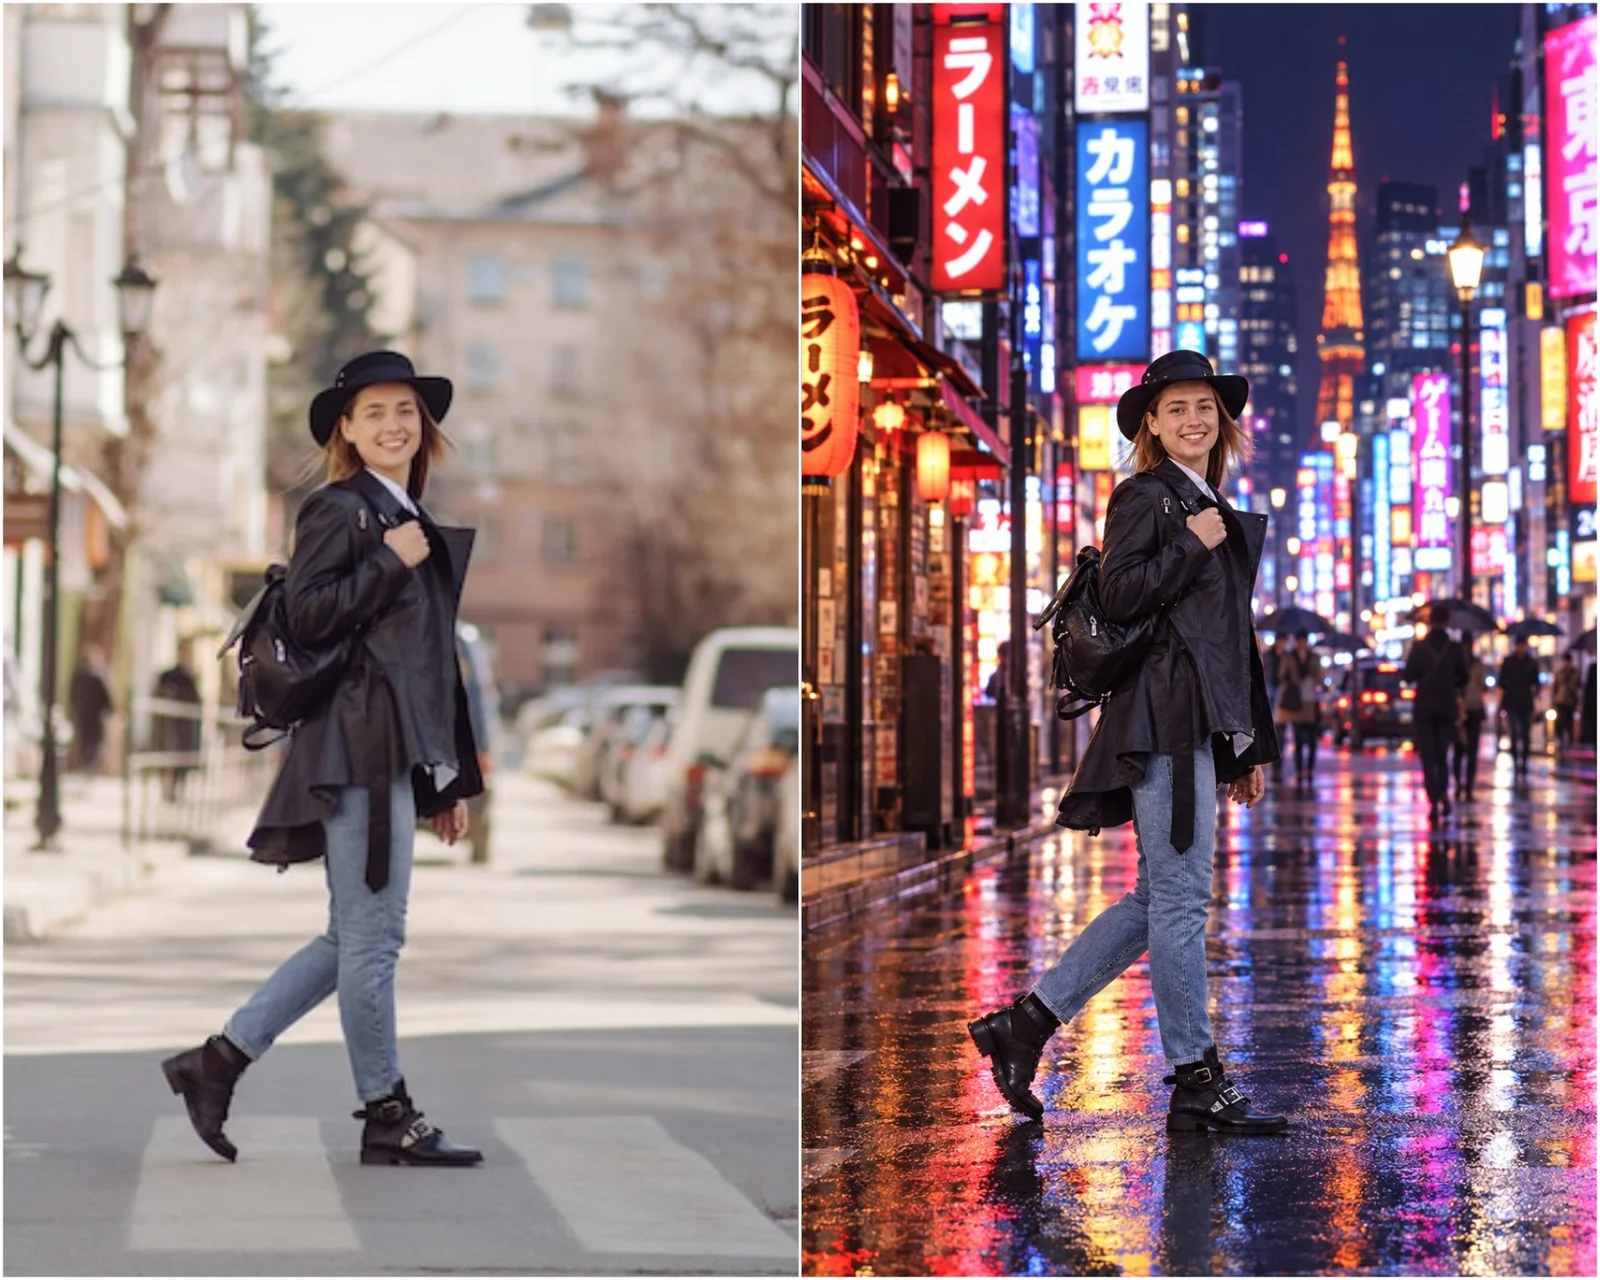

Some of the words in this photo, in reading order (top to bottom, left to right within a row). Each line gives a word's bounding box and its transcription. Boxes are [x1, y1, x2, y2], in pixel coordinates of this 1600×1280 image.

[943, 37, 993, 280] ラーメン
[1085, 128, 1138, 354] カラオケ
